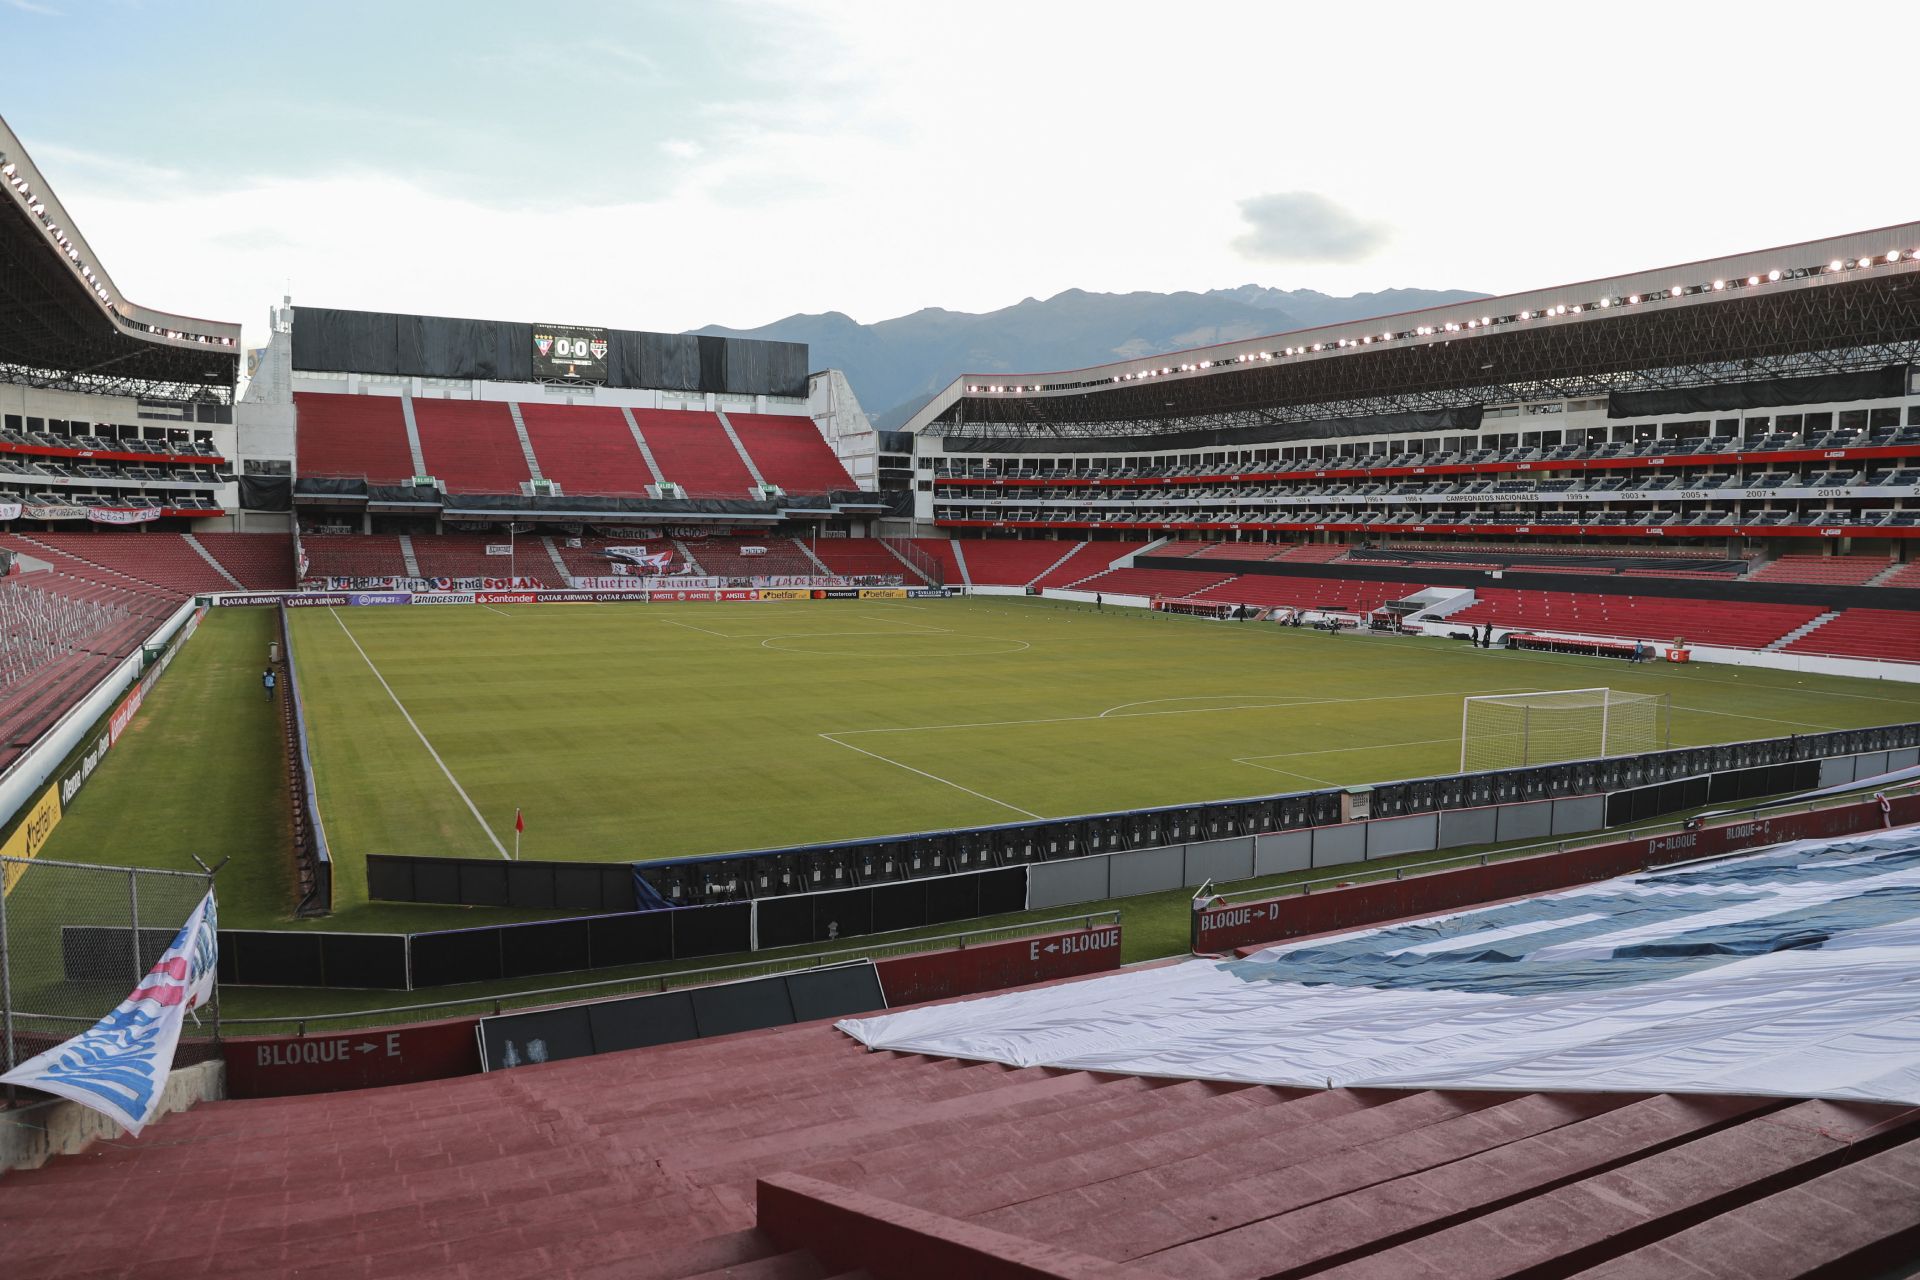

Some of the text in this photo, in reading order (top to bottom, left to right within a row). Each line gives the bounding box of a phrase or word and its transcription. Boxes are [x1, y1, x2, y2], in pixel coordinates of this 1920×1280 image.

[1681, 491, 1701, 499] 2005
[1746, 490, 1767, 498] 2007
[1818, 489, 1841, 497] 2010
[222, 596, 281, 606] QATAR AIRWAYS
[287, 597, 346, 607] QATAR AIRWAYS
[414, 595, 474, 604] BRIDGESTONE
[488, 594, 534, 603] Santander
[563, 593, 593, 601] AIRWAYS
[1670, 651, 1679, 660] G
[62, 770, 81, 806] Rexona
[1726, 820, 1770, 840] BLOQUE C
[1649, 834, 1697, 854] D BLOQUE
[1201, 904, 1279, 931] BLOQUE D
[1030, 930, 1119, 960] E BLOQUE
[257, 1033, 400, 1066] BLOQUE E
